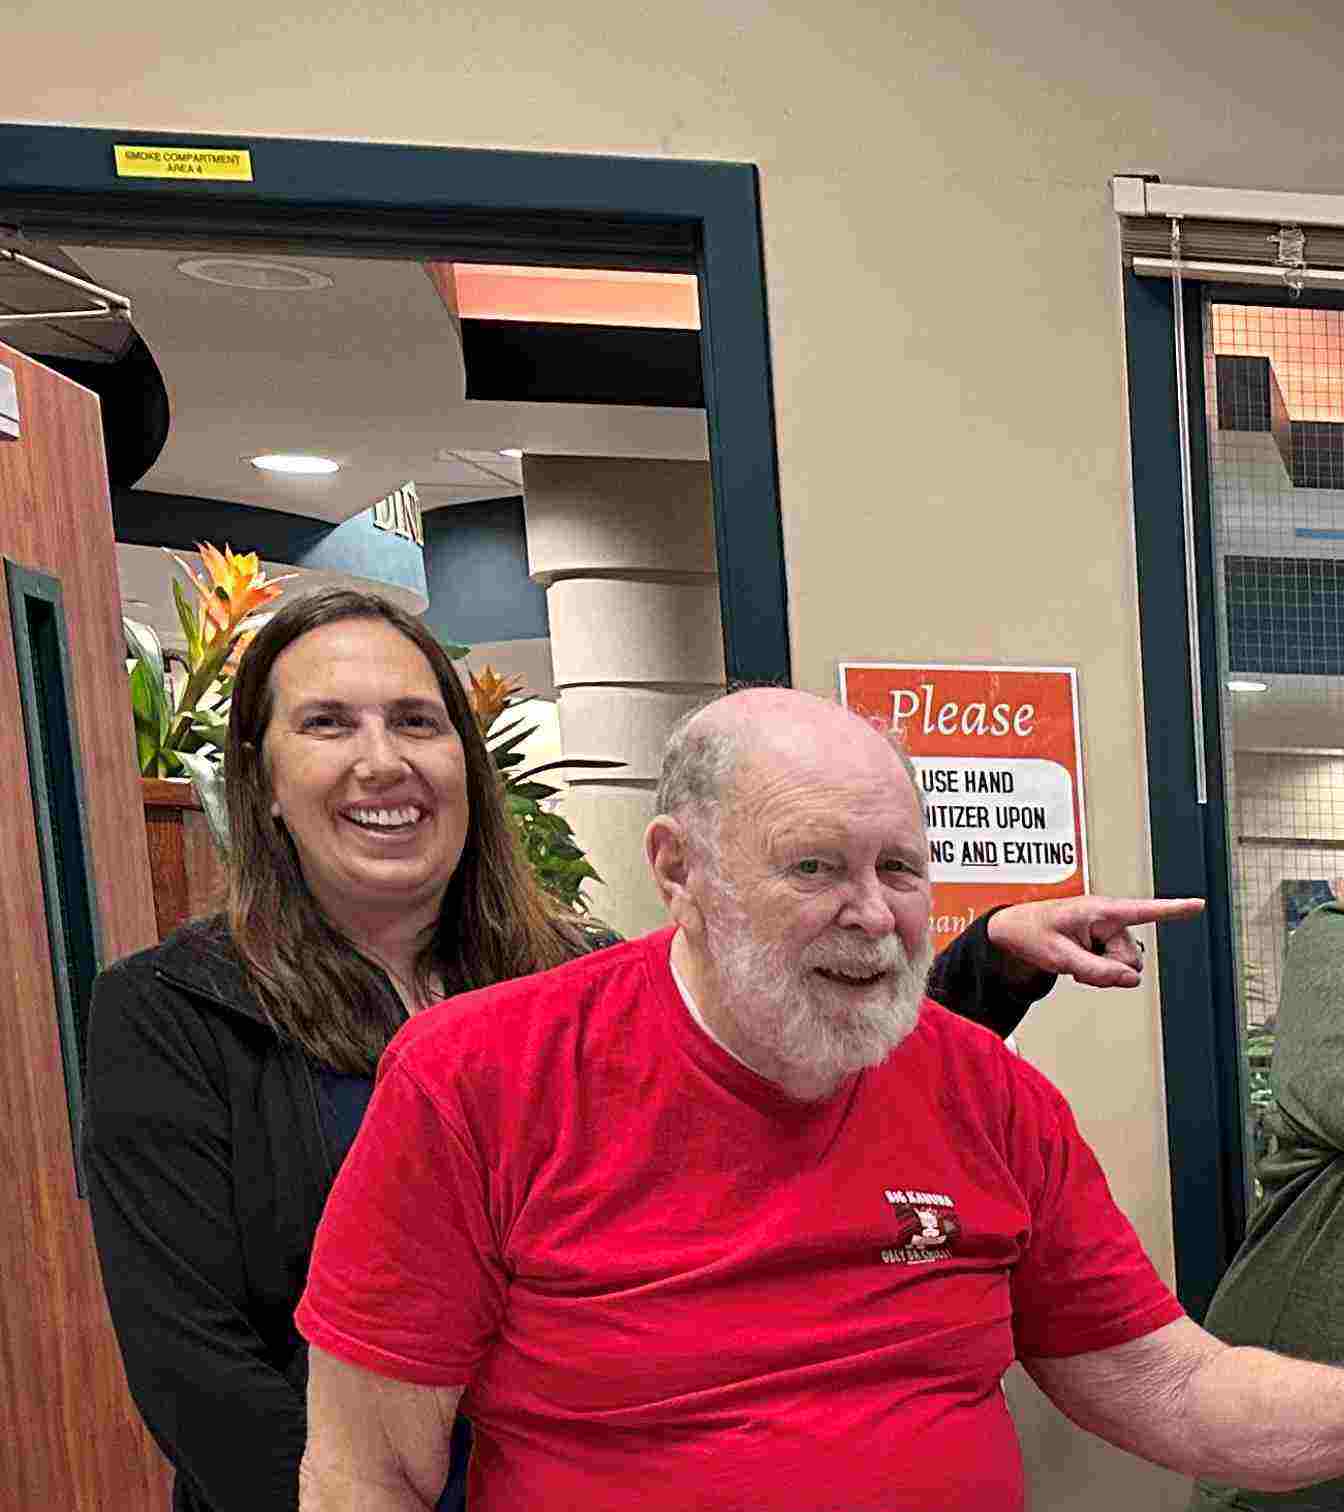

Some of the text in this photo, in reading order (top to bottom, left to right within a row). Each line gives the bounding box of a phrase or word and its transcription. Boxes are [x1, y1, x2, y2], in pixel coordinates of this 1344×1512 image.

[125, 151, 240, 165] SMOKE COMPARTMENT
[888, 684, 1035, 737] Please
[922, 770, 1014, 793] USE HAND
[925, 805, 1047, 829] ITIZER UPON
[961, 841, 998, 864] AND
[1004, 841, 1075, 865] EXITING
